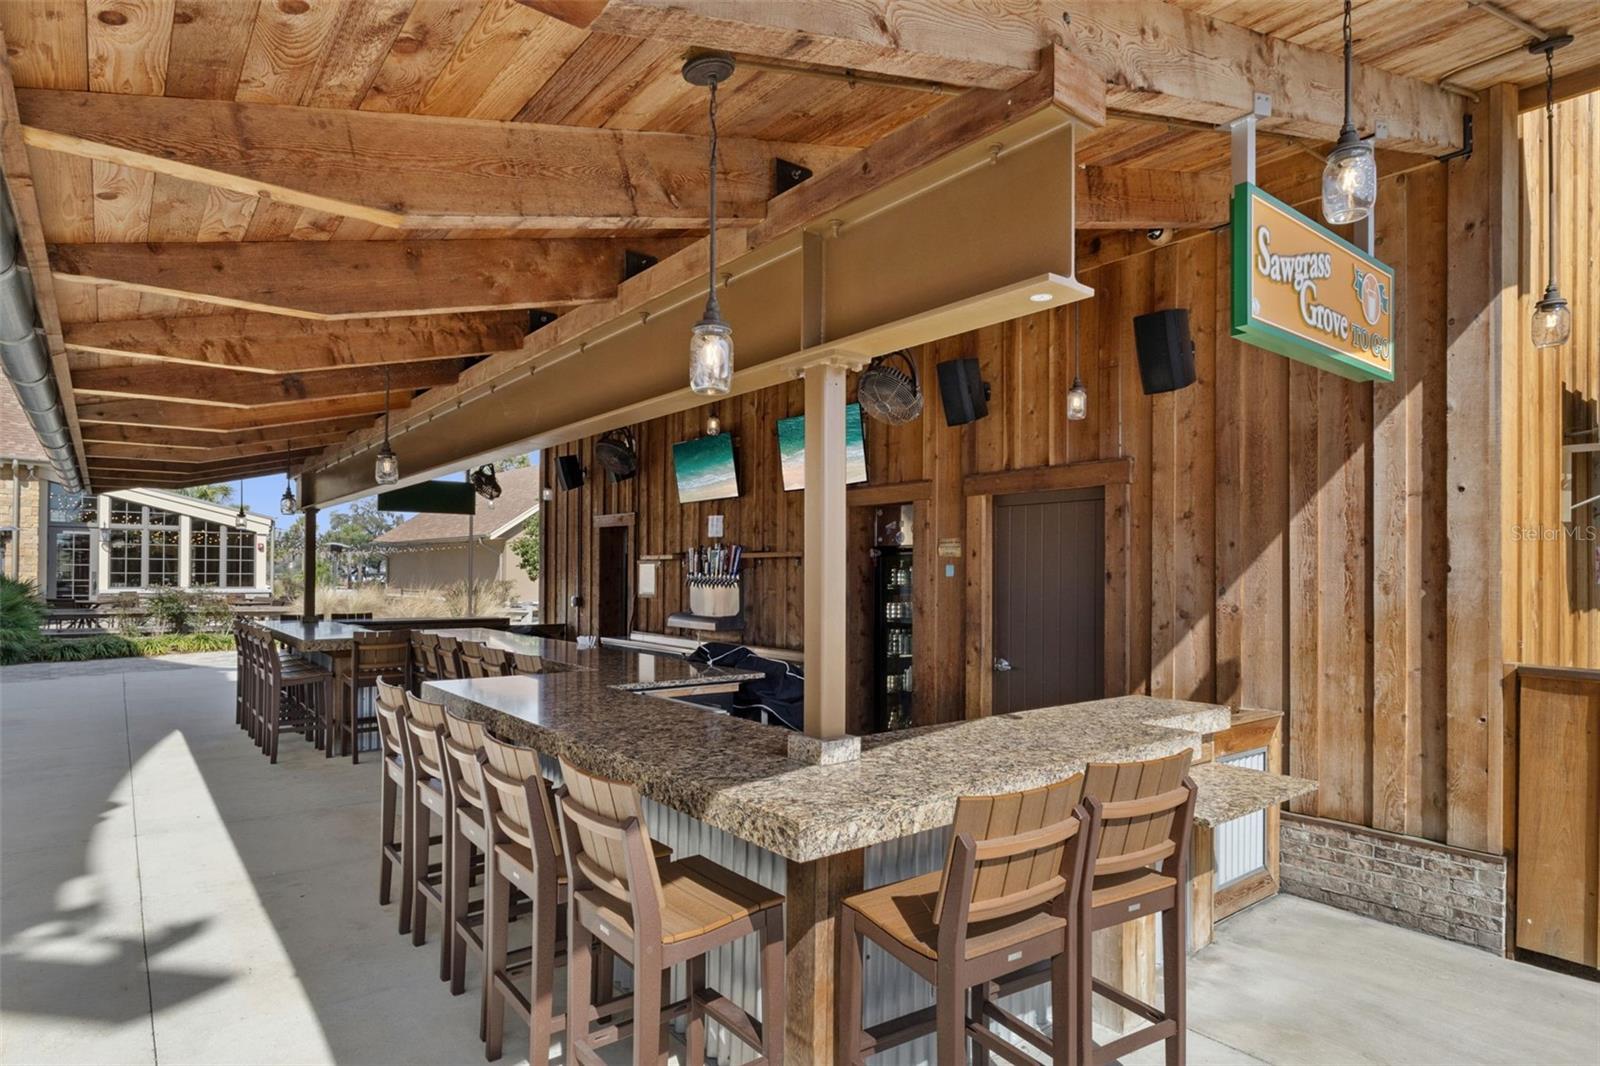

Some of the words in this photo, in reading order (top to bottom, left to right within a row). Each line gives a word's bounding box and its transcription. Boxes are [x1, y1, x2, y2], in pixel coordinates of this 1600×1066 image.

[1257, 226, 1331, 291] Sawgrass
[1300, 280, 1348, 340] Grove
[1351, 323, 1370, 352] TO
